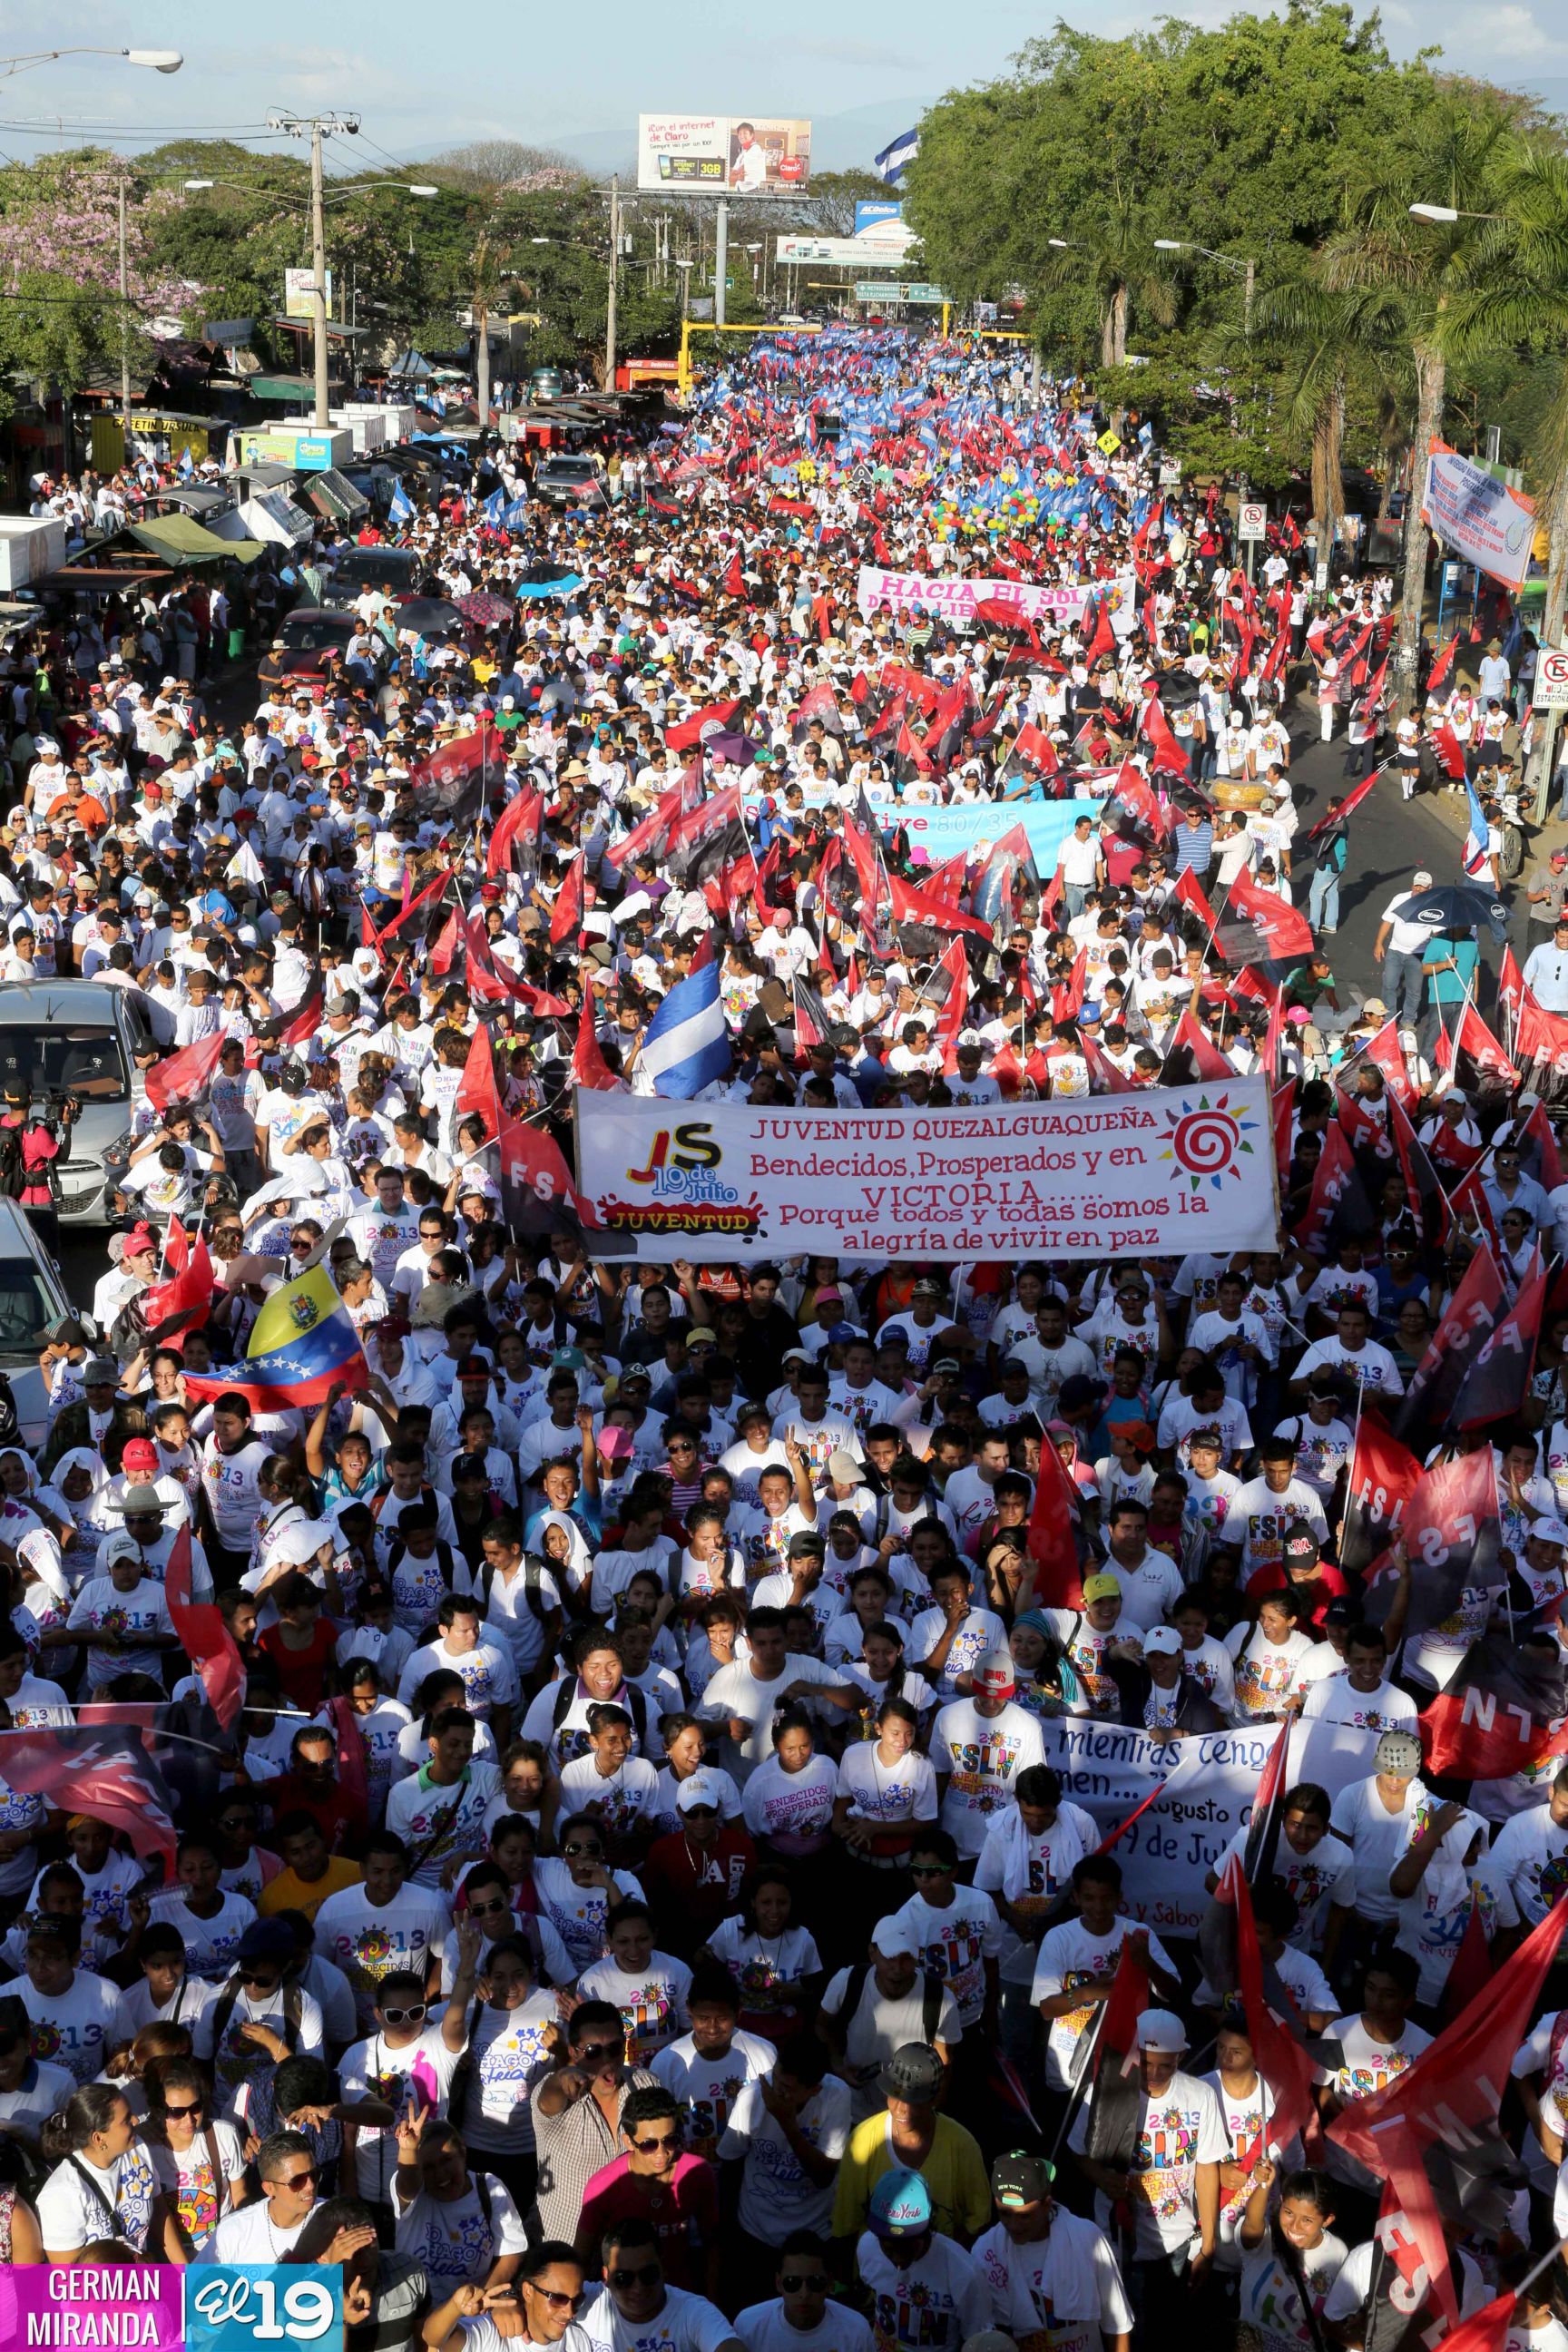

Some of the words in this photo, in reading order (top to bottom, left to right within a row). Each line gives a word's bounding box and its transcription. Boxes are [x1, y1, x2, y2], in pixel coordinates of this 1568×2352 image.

[650, 133, 661, 142] de
[664, 132, 689, 142] Claro
[701, 163, 721, 174] 3GB
[861, 205, 897, 214] ACDelco
[879, 575, 979, 602] HACIA
[993, 583, 1026, 605] EL
[1536, 694, 1568, 703] ESTACIONA
[1426, 736, 1452, 769] FSLN
[936, 813, 1022, 834] 80/35
[750, 1119, 906, 1141] JUVENTUD
[913, 1106, 1158, 1142] QUEZALGUAQUEÑA
[626, 1122, 721, 1185] JS
[750, 1152, 915, 1179] Bendecidos,
[917, 1146, 1076, 1181] Prosperados
[1082, 1150, 1102, 1176] y
[1109, 1145, 1148, 1166] en
[652, 1166, 688, 1196] 19
[689, 1163, 717, 1183] de
[684, 1181, 739, 1203] Julio
[612, 1212, 750, 1230] JUVENTUD
[779, 1205, 880, 1230] Porque
[890, 1207, 964, 1223] todos
[971, 1209, 989, 1226] y
[998, 1202, 1075, 1222] todas
[1083, 1197, 1171, 1220] somos
[1178, 1192, 1210, 1214] la
[843, 1228, 948, 1255] alegría
[953, 1228, 983, 1250] de
[989, 1226, 1061, 1249] vivir
[1066, 1230, 1103, 1248] en
[1108, 1228, 1160, 1252] paz
[1146, 1824, 1179, 1860] de
[1008, 2183, 1024, 2192] YORK
